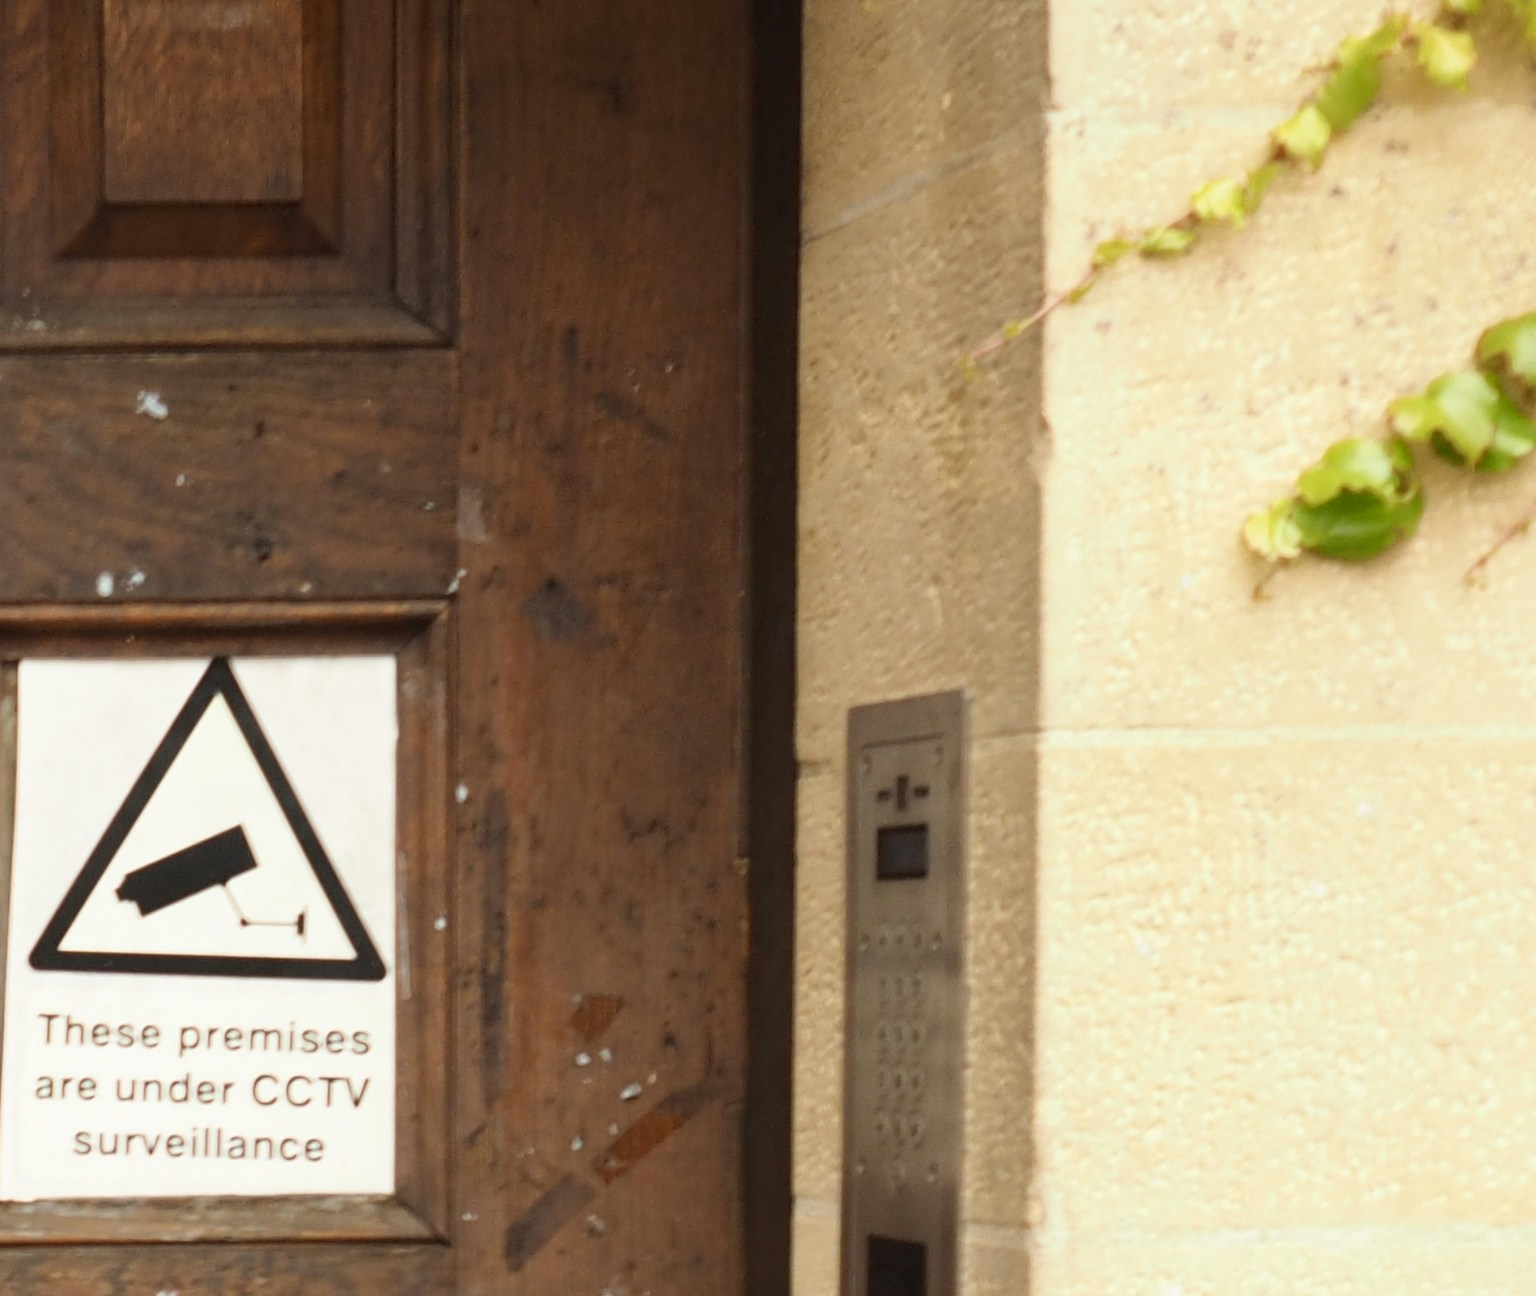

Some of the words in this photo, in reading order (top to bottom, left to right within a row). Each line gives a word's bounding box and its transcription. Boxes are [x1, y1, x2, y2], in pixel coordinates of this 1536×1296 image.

[36, 1013, 161, 1049] These
[179, 1020, 371, 1057] premises
[35, 1074, 97, 1101] are
[116, 1074, 235, 1105] under
[251, 1074, 371, 1108] CCTV
[73, 1128, 327, 1163] surveillance
